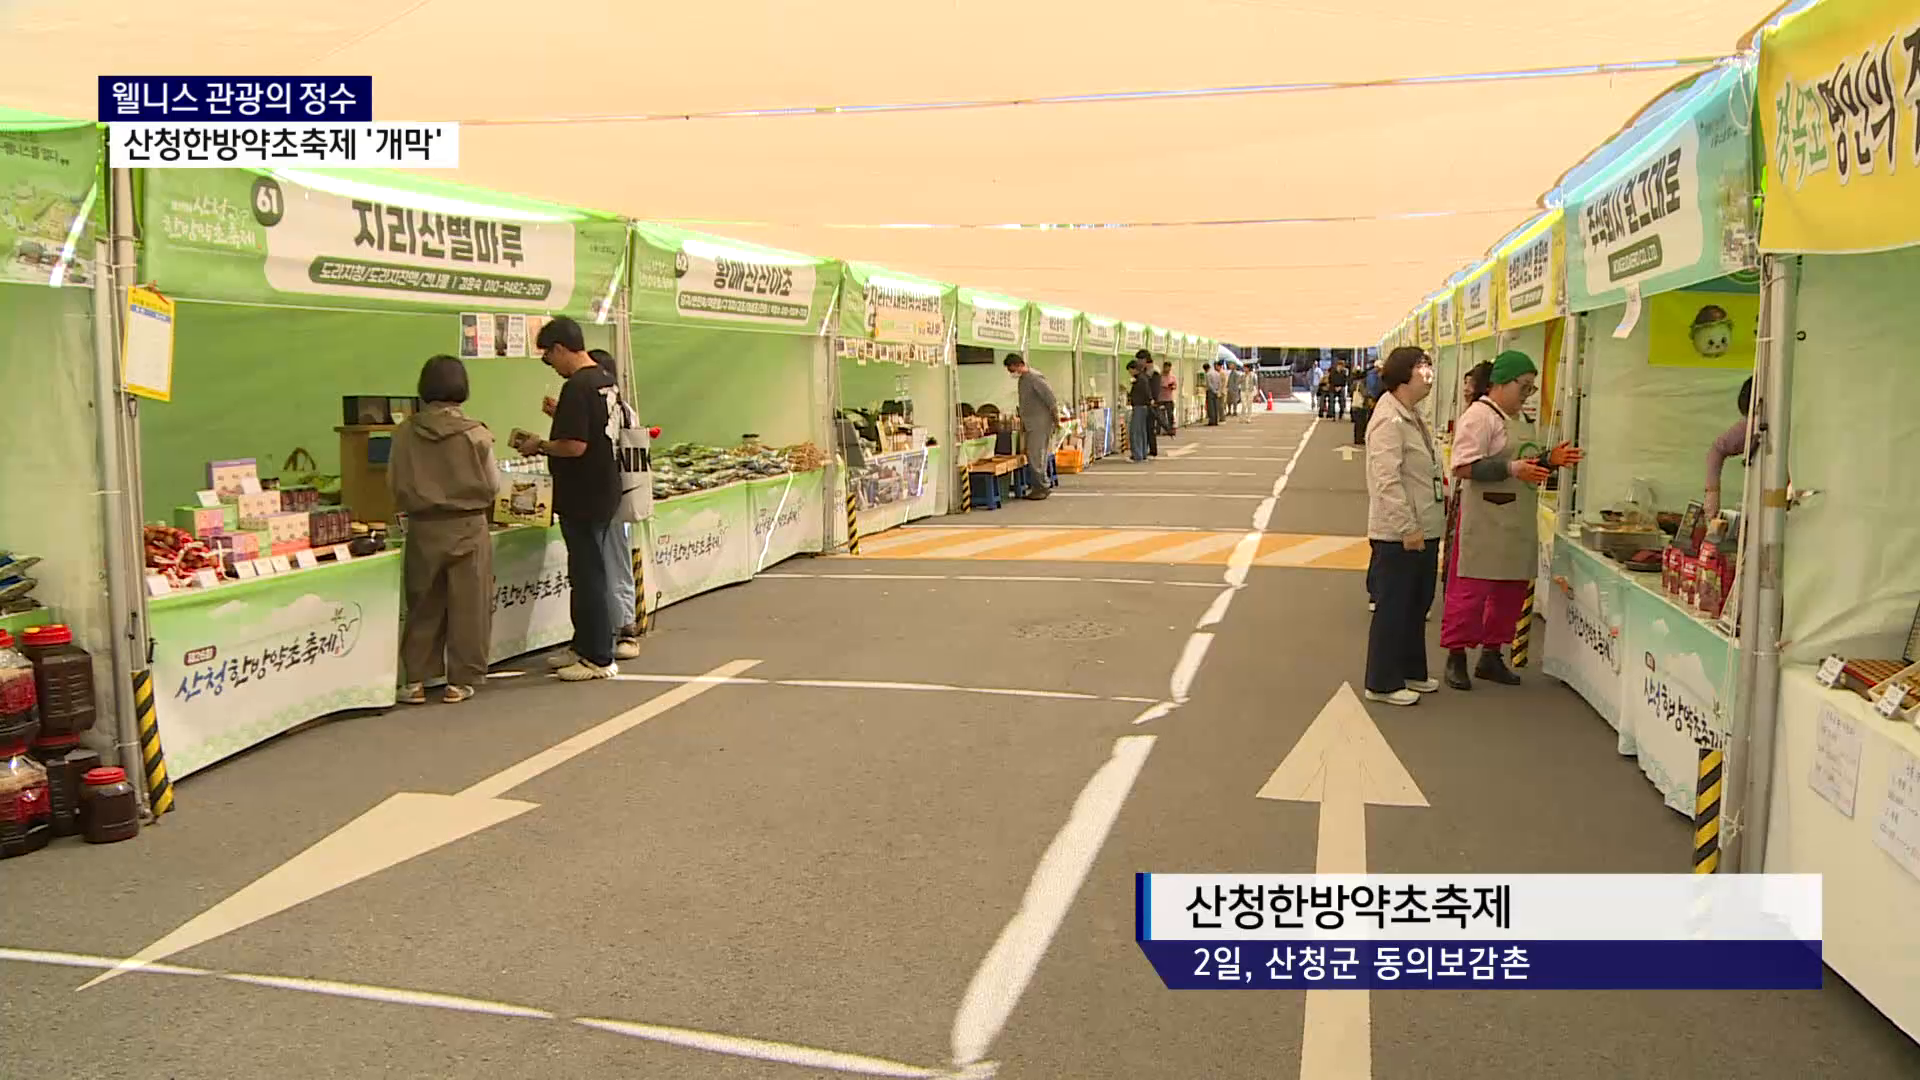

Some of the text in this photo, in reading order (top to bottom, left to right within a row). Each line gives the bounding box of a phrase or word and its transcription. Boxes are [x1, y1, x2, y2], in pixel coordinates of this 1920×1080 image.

[1817, 35, 1896, 175] 명인의
[256, 186, 279, 214] 61
[351, 199, 524, 268] 지리산별마루
[1586, 146, 1682, 253] 주식회사 원그대로
[174, 631, 338, 702] 산청한방약초축제
